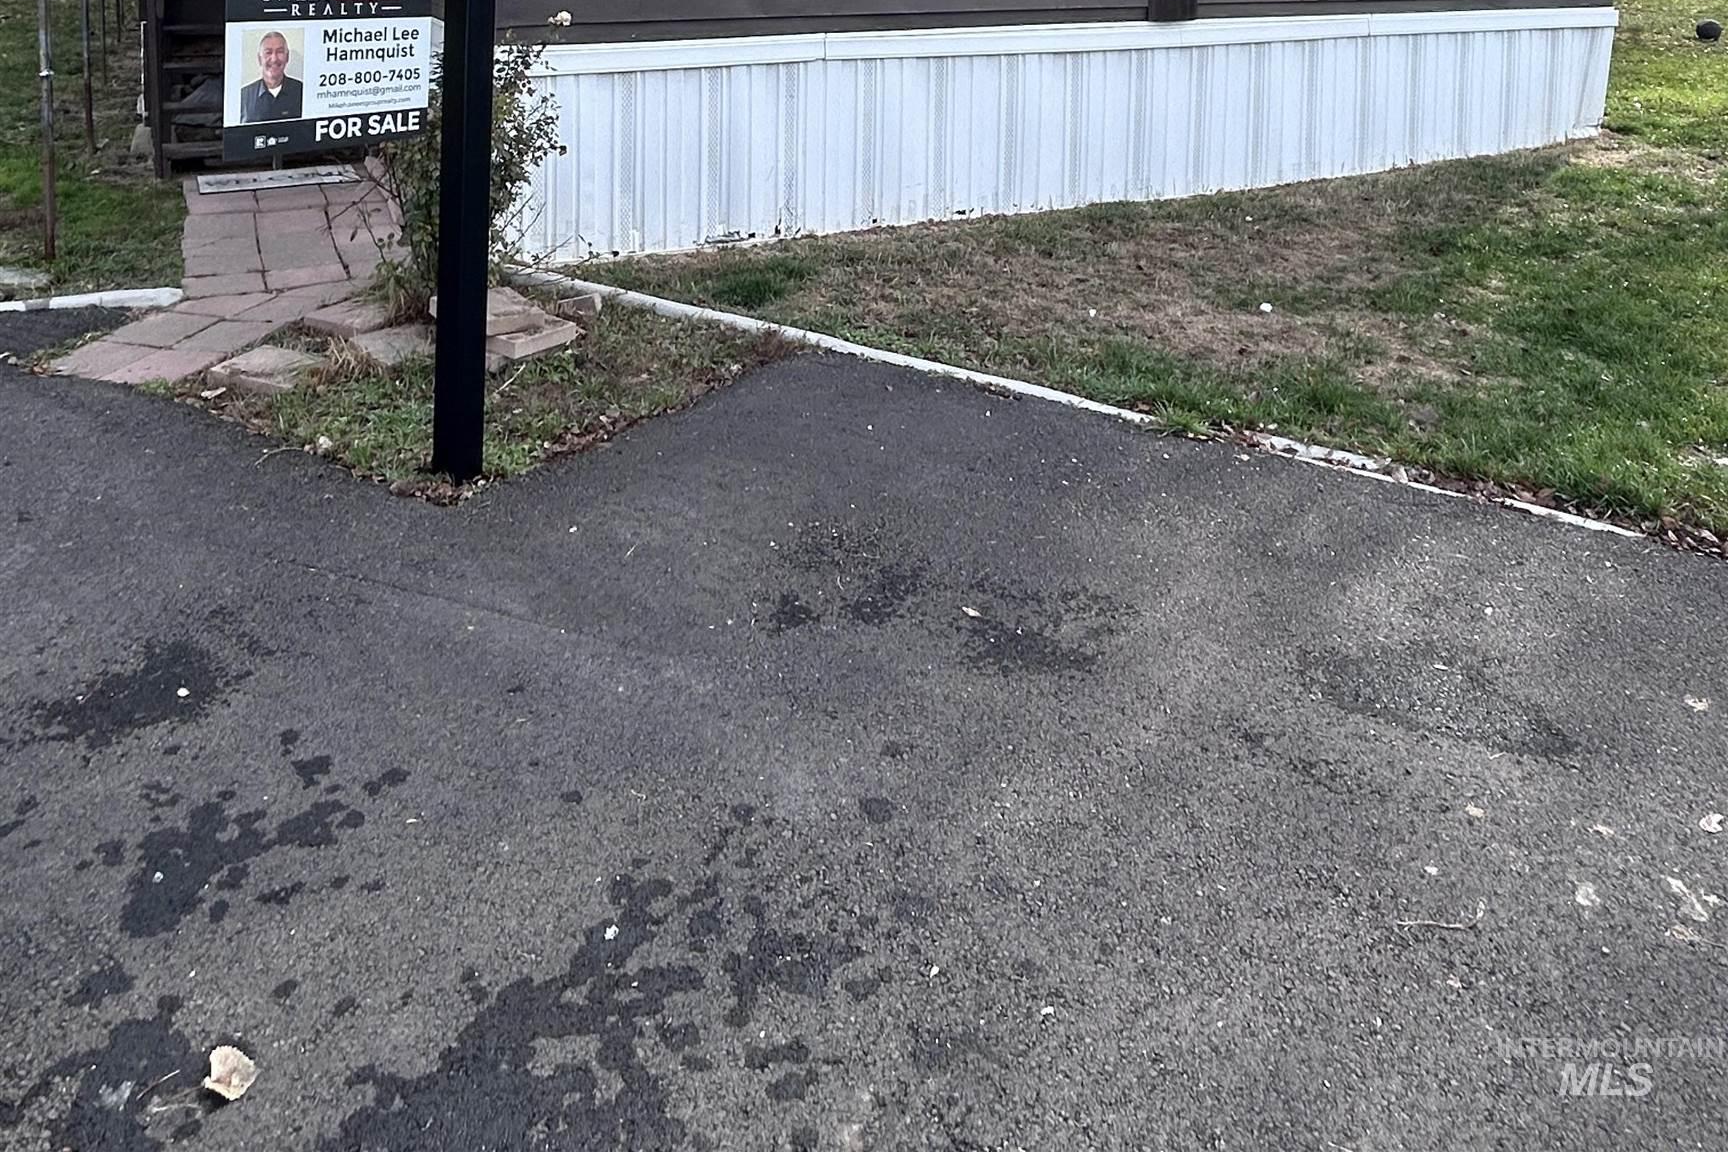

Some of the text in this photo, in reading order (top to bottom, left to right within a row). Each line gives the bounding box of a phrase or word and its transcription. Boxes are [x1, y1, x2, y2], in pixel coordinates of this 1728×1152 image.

[291, 2, 379, 17] REALTY
[322, 26, 420, 44] Michael Lee
[326, 43, 415, 62] Hamnquist
[319, 67, 421, 87] 208-800-7405
[315, 111, 420, 142] FOR SALE
